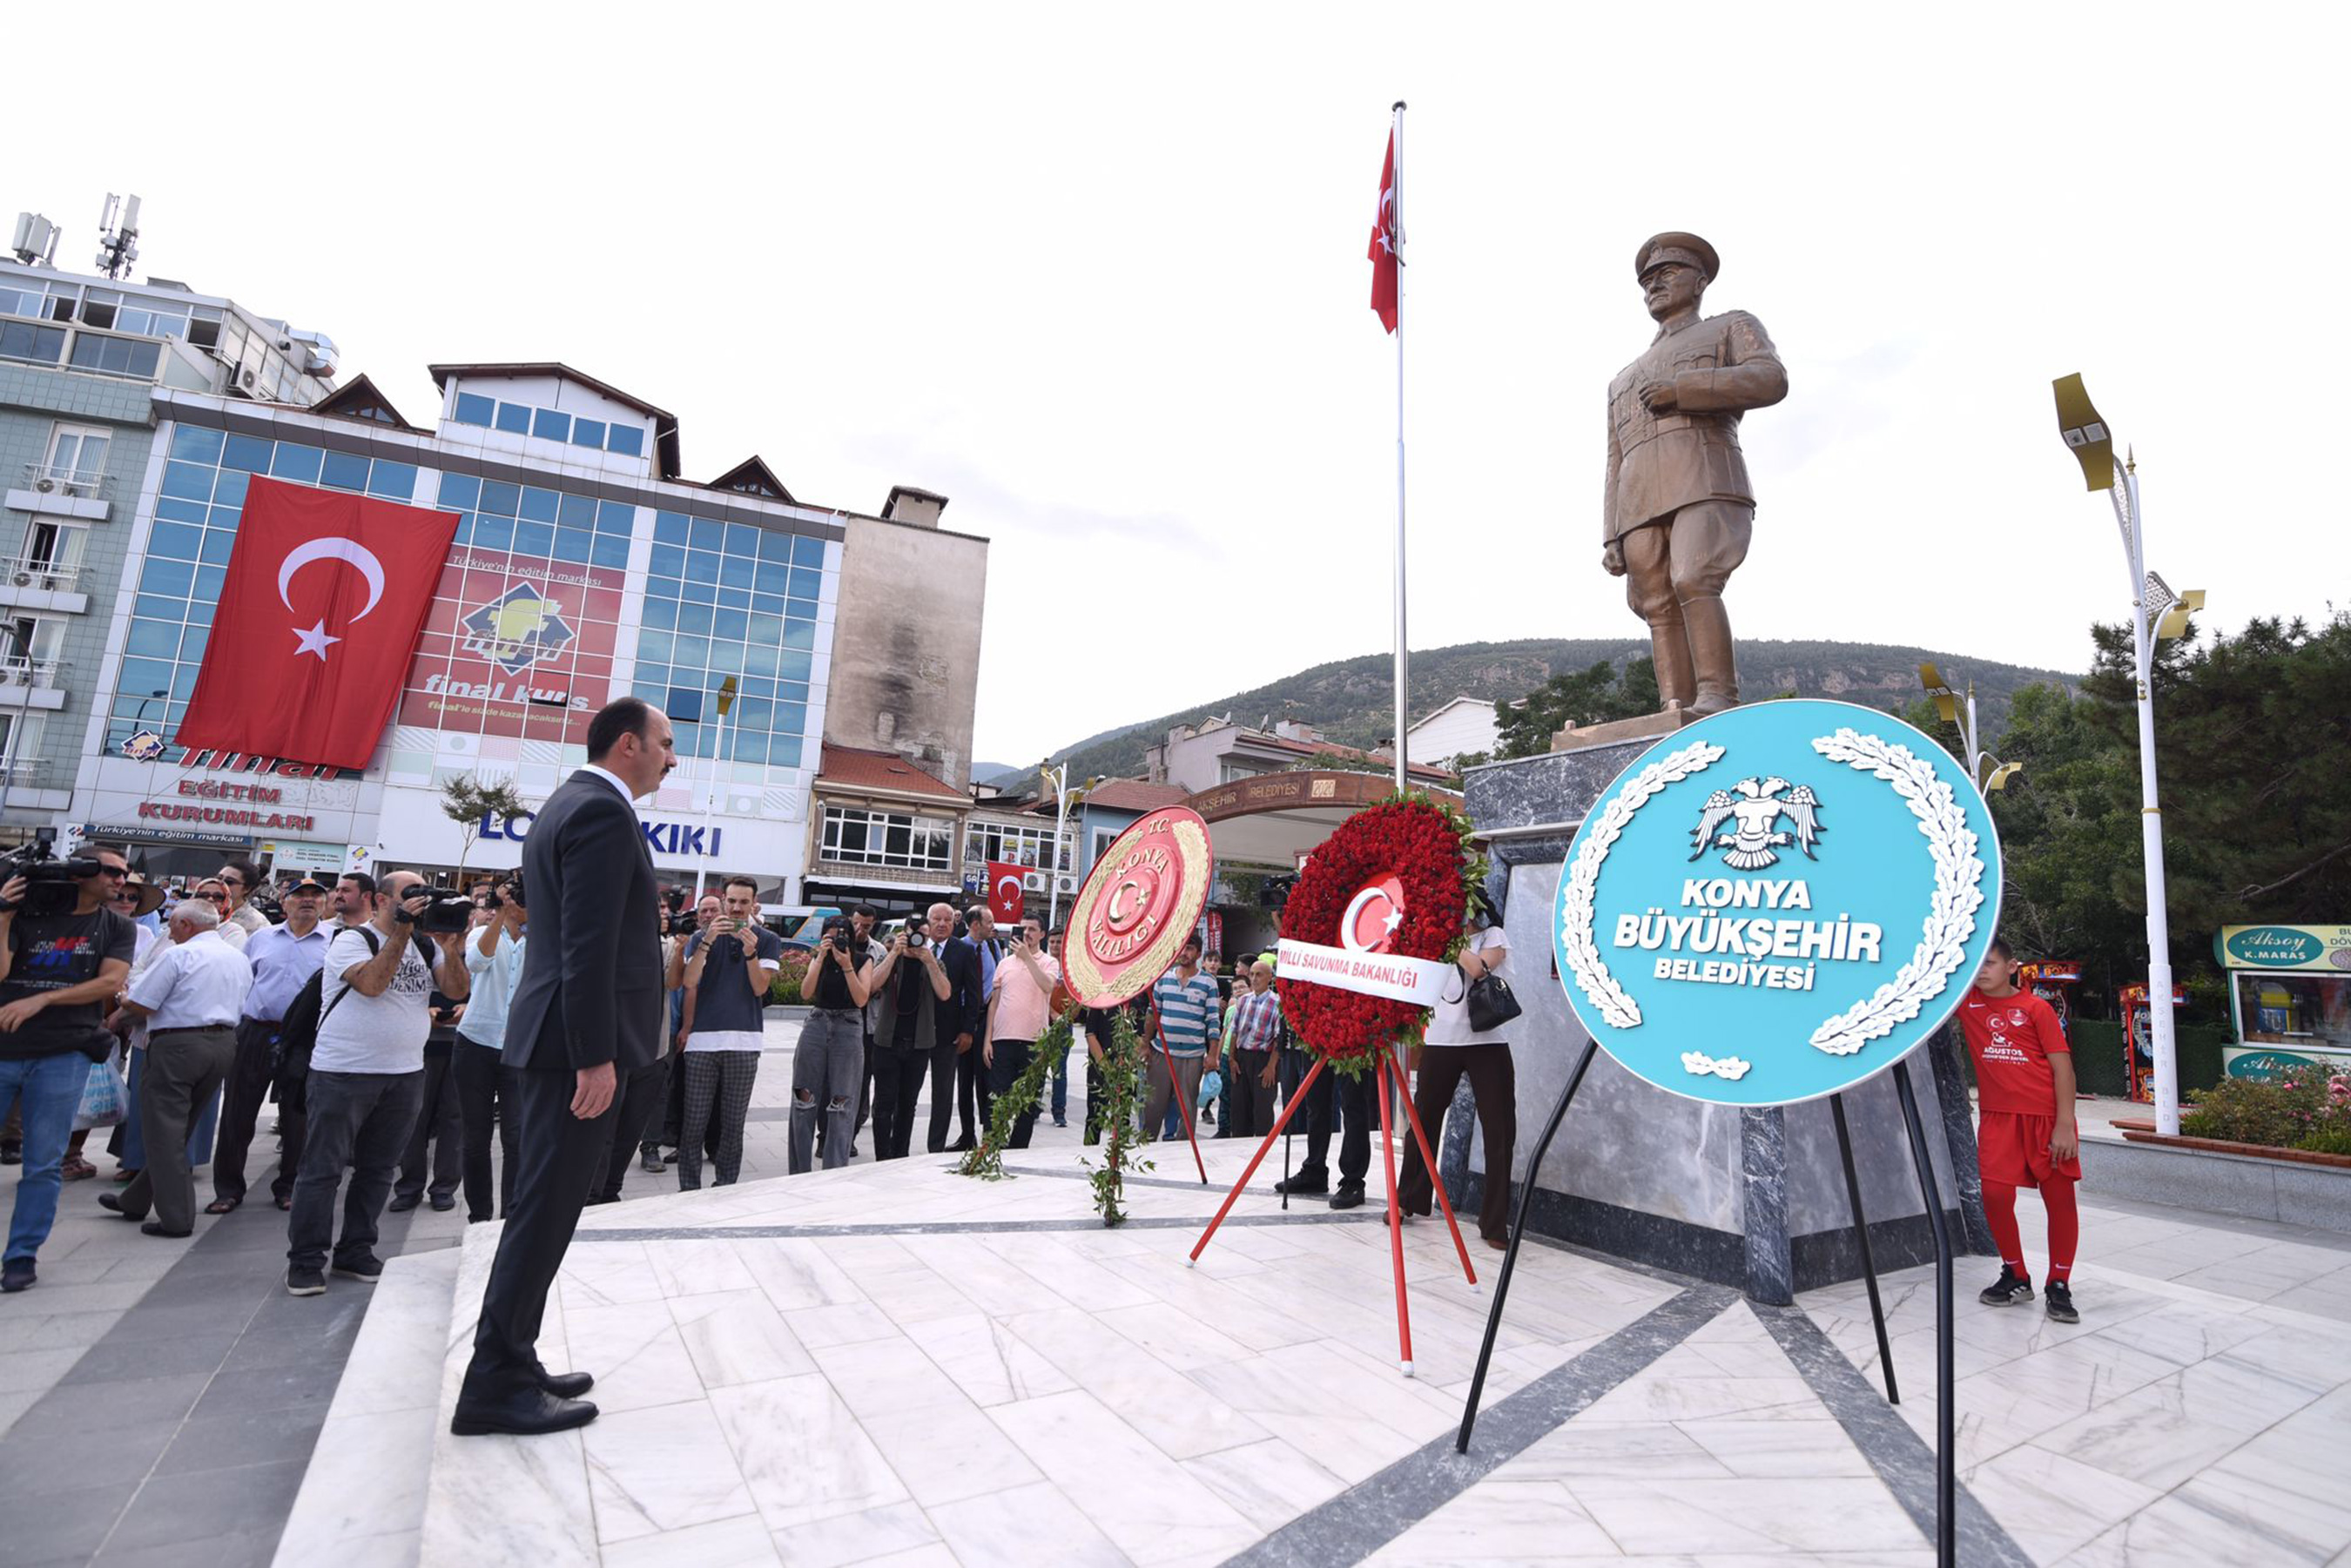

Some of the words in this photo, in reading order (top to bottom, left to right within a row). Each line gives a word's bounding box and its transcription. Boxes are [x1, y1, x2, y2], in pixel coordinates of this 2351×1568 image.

[517, 566, 555, 579] eğitim
[557, 572, 602, 587] markası
[425, 673, 505, 700] final
[513, 684, 589, 710] kurs
[178, 779, 282, 804] EĞİTİM
[138, 802, 316, 831] KURUMLARI
[1148, 818, 1171, 835] T.C.
[198, 833, 244, 843] markası
[641, 821, 722, 857] KIKI
[1117, 847, 1170, 880] KONYA
[1681, 878, 1812, 910] KONYA
[1613, 907, 1883, 962] BÜYÜKŞEHİR
[2241, 931, 2307, 952] Aksoy
[1279, 947, 1302, 966] MİLLİ
[1301, 952, 1350, 975] SAVUNMA
[1351, 961, 1418, 989] BAKANLIĞI
[1654, 958, 1815, 991] BELEDİYESİ
